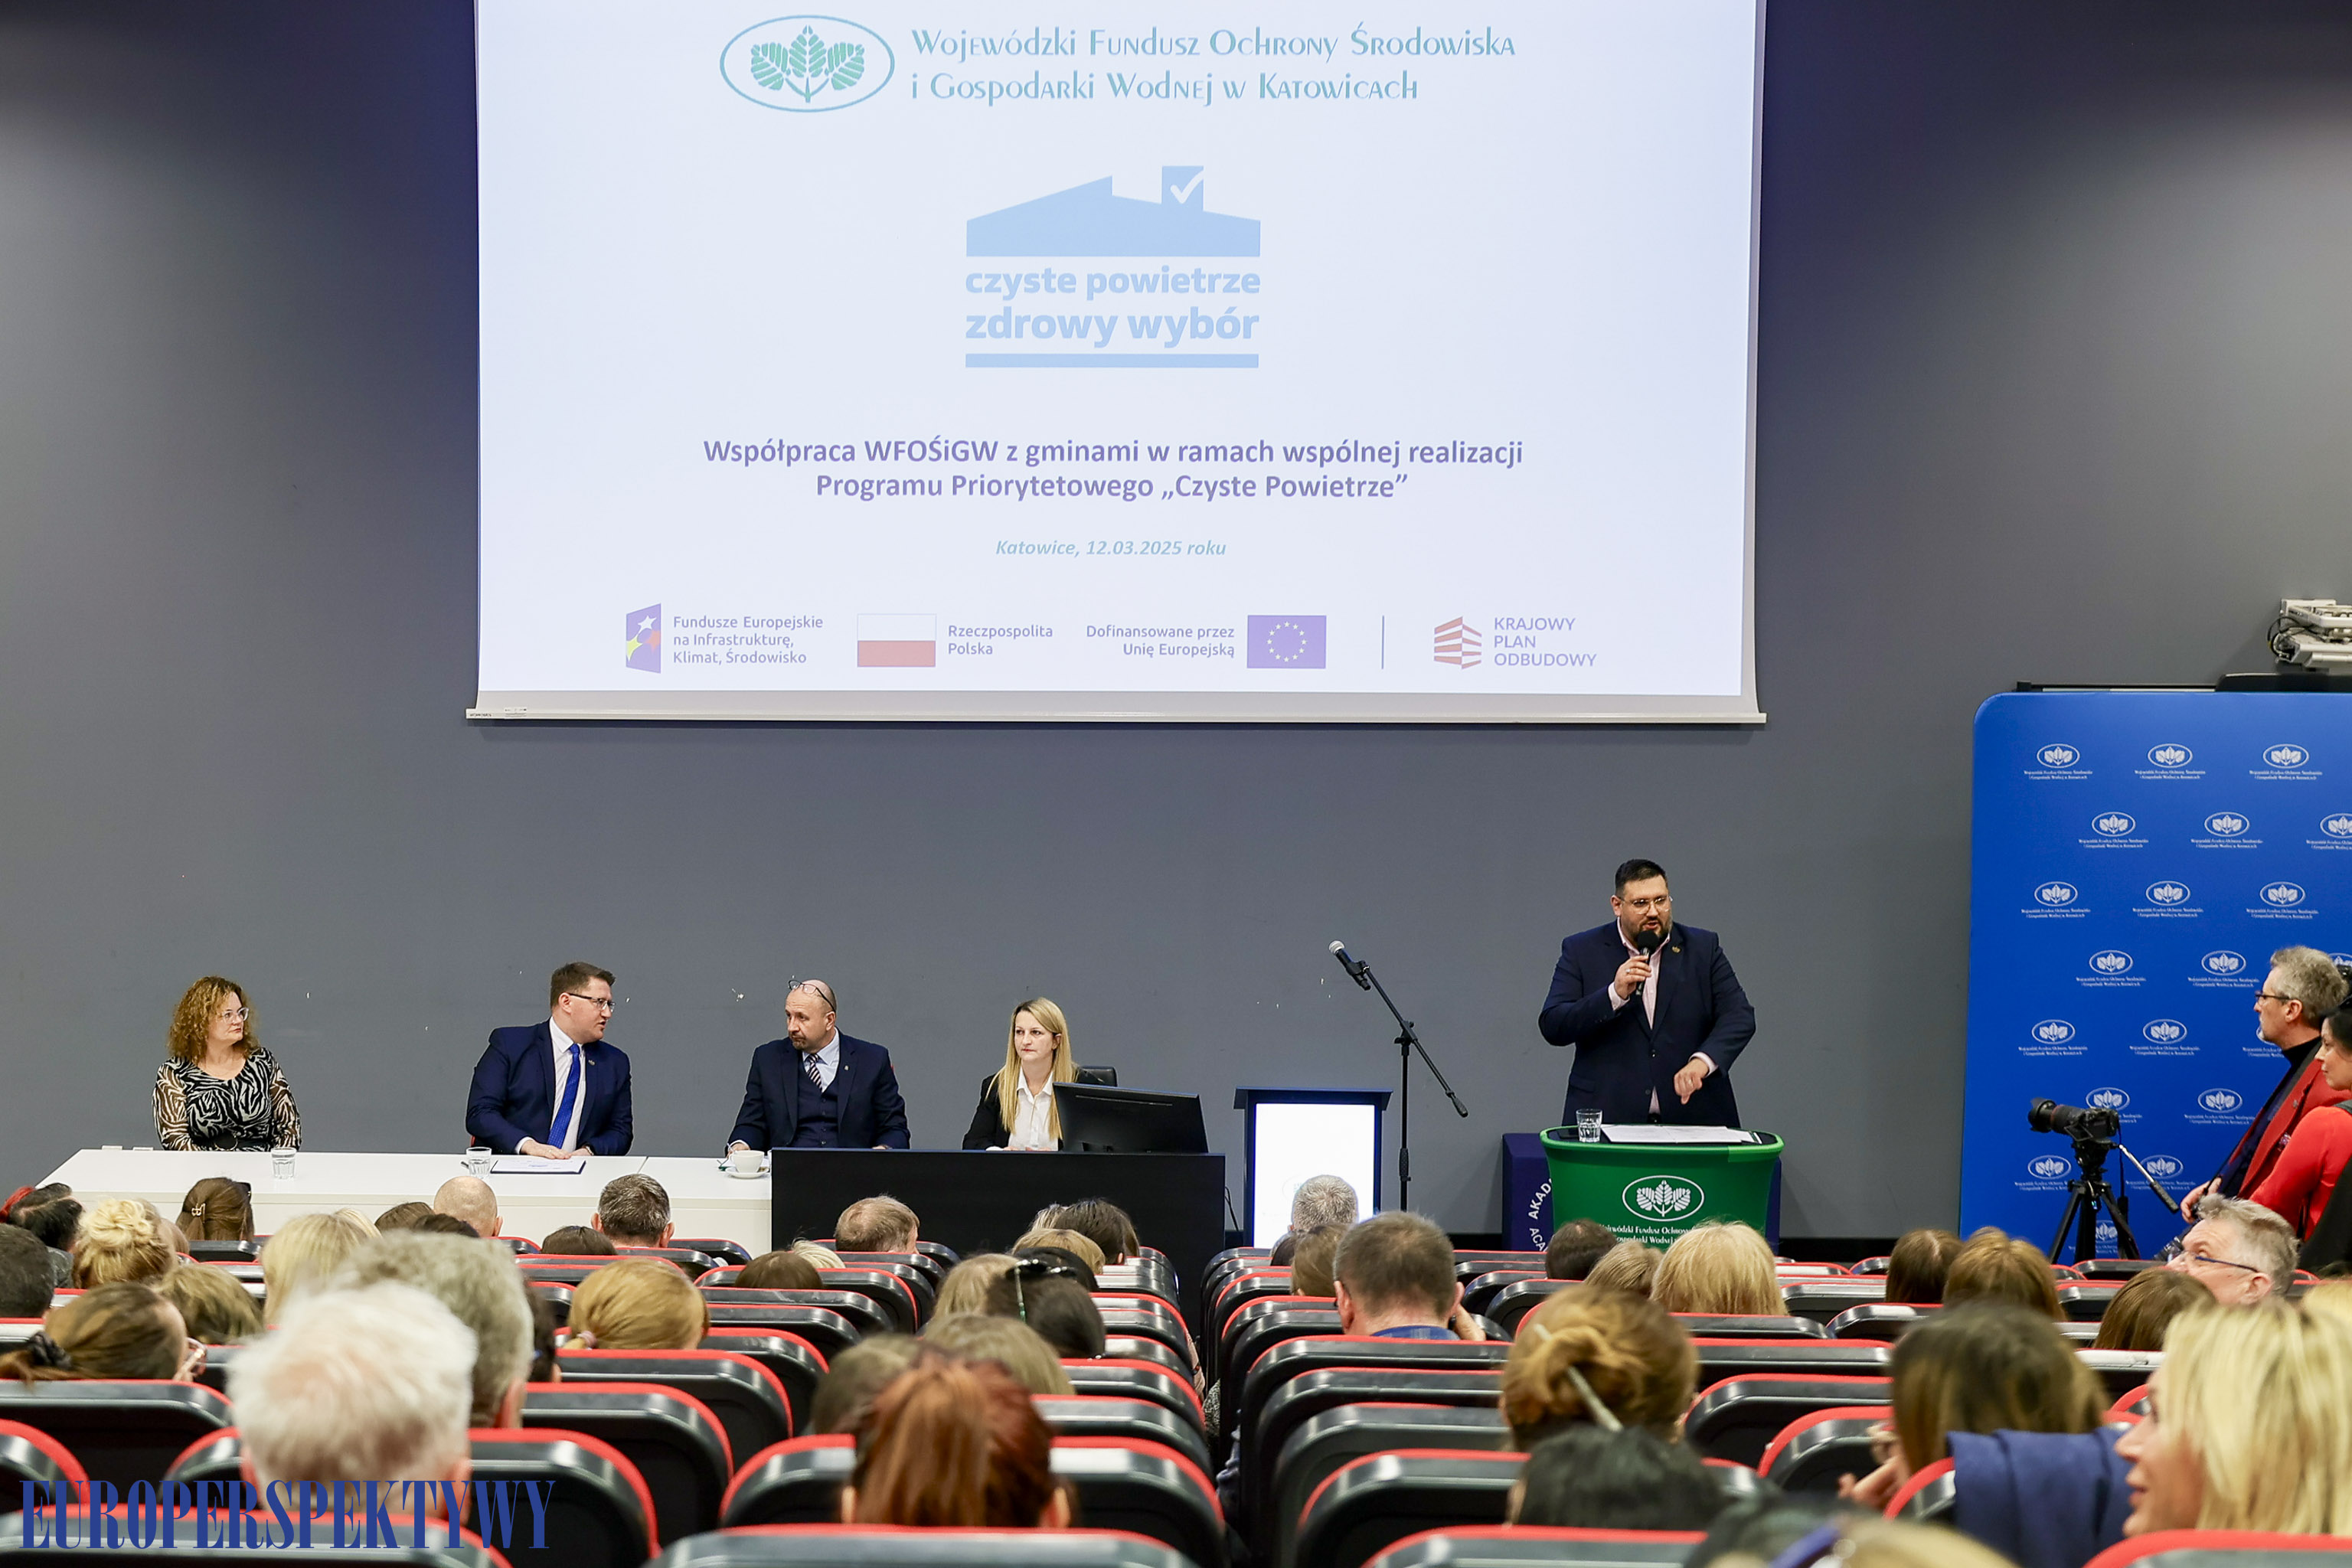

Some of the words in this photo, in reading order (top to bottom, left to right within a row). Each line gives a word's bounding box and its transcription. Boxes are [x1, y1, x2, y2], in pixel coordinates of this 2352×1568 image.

[912, 73, 918, 100] i
[1223, 80, 1246, 100] w
[965, 268, 1077, 301] czyste
[1086, 266, 1261, 301] powietrze
[965, 306, 1119, 348] zdrowy
[1126, 306, 1260, 348] wybór
[704, 438, 855, 467] Współpraca
[864, 435, 998, 462] WFOŚiGW
[1007, 445, 1018, 462] z
[1026, 439, 1138, 468] gminami
[1148, 445, 1170, 462] w
[1179, 439, 1273, 462] ramach
[1282, 438, 1400, 468] wspólnej
[1410, 439, 1522, 468] realizacji
[817, 475, 942, 502] Programu
[952, 473, 1153, 502] Priorytetowego
[996, 539, 1080, 558] Katowice,
[1086, 540, 1182, 556] 12.03.2025
[1187, 539, 1227, 556] roku
[674, 615, 737, 629] Fundusze
[743, 614, 823, 631] Europejskie
[1494, 617, 1576, 631] KRAJOWY
[674, 635, 690, 646] na
[694, 632, 794, 648] Infrastrukturę,
[949, 624, 1053, 640] Rzeczpospolita
[1087, 624, 1193, 638] Dofinansowane
[1198, 627, 1235, 641] przez
[949, 642, 993, 656] Polska
[1494, 635, 1536, 648] PLAN
[674, 650, 722, 666] Klimat,
[727, 648, 806, 664] Środowisko
[1123, 642, 1154, 658] Unię
[1159, 642, 1235, 659] Europejską
[1494, 652, 1597, 667] ODBUDOWY
